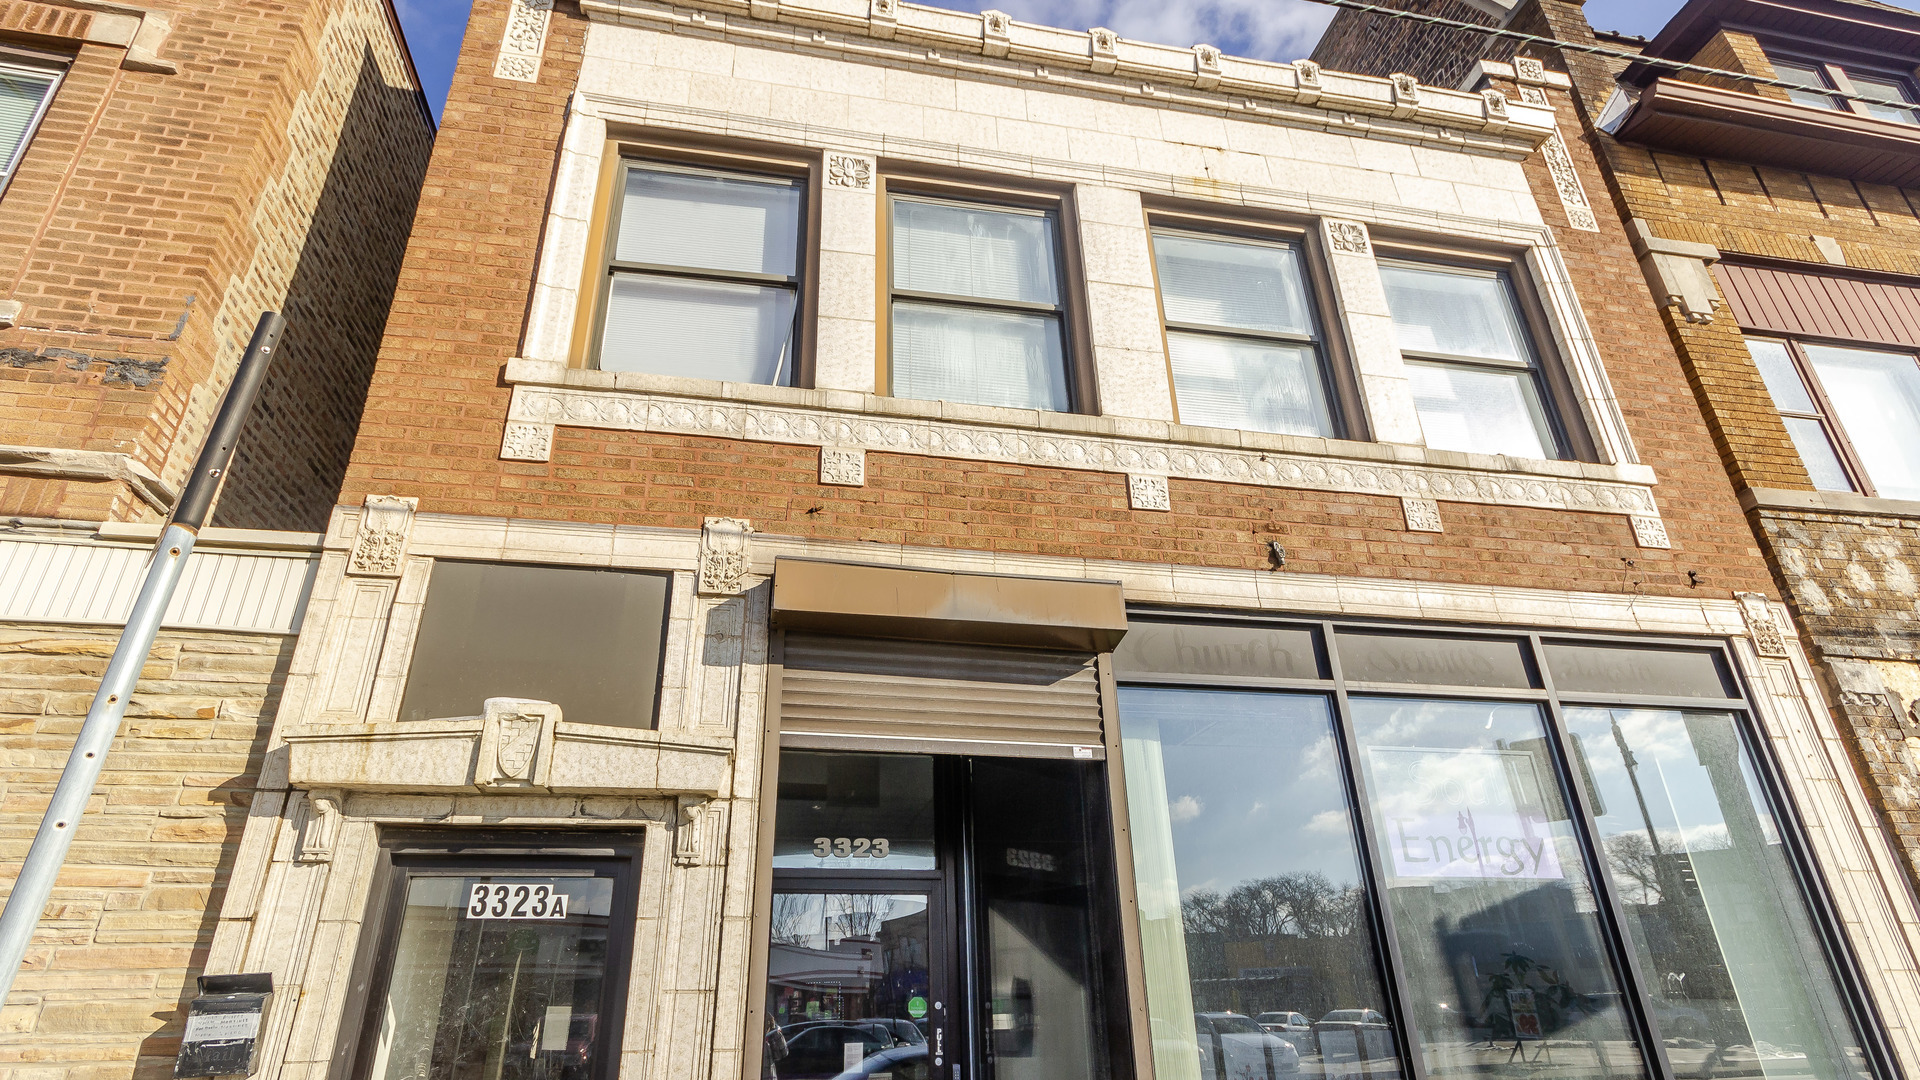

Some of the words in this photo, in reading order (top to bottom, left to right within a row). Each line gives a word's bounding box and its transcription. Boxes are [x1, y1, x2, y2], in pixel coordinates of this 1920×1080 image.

[813, 837, 890, 858] 3323
[1391, 818, 1544, 876] Energy
[471, 885, 564, 917] 3323A
